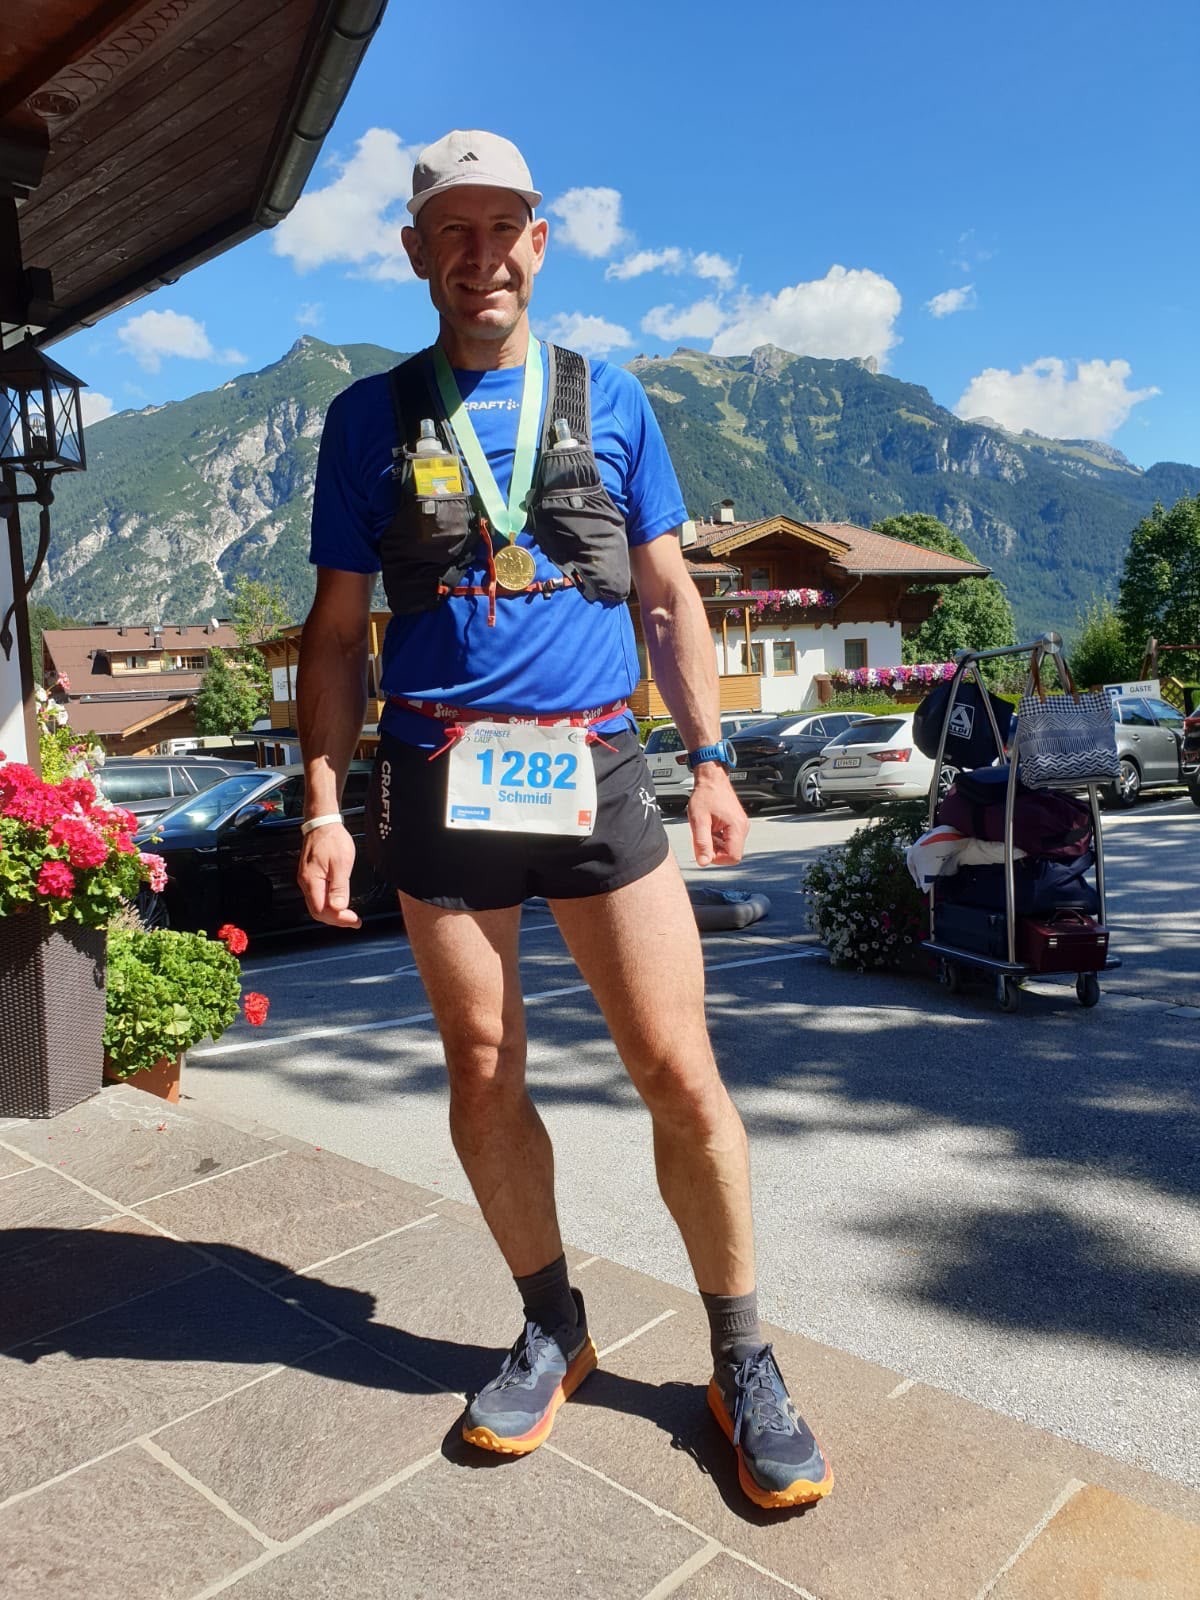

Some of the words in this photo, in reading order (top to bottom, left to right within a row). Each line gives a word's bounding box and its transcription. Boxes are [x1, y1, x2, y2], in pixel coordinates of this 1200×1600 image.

[463, 400, 506, 410] CRAFT
[473, 728, 511, 738] ACHENSEE
[476, 748, 578, 790] 1282
[381, 760, 391, 823] CRAFT
[497, 790, 552, 805] Schmidi
